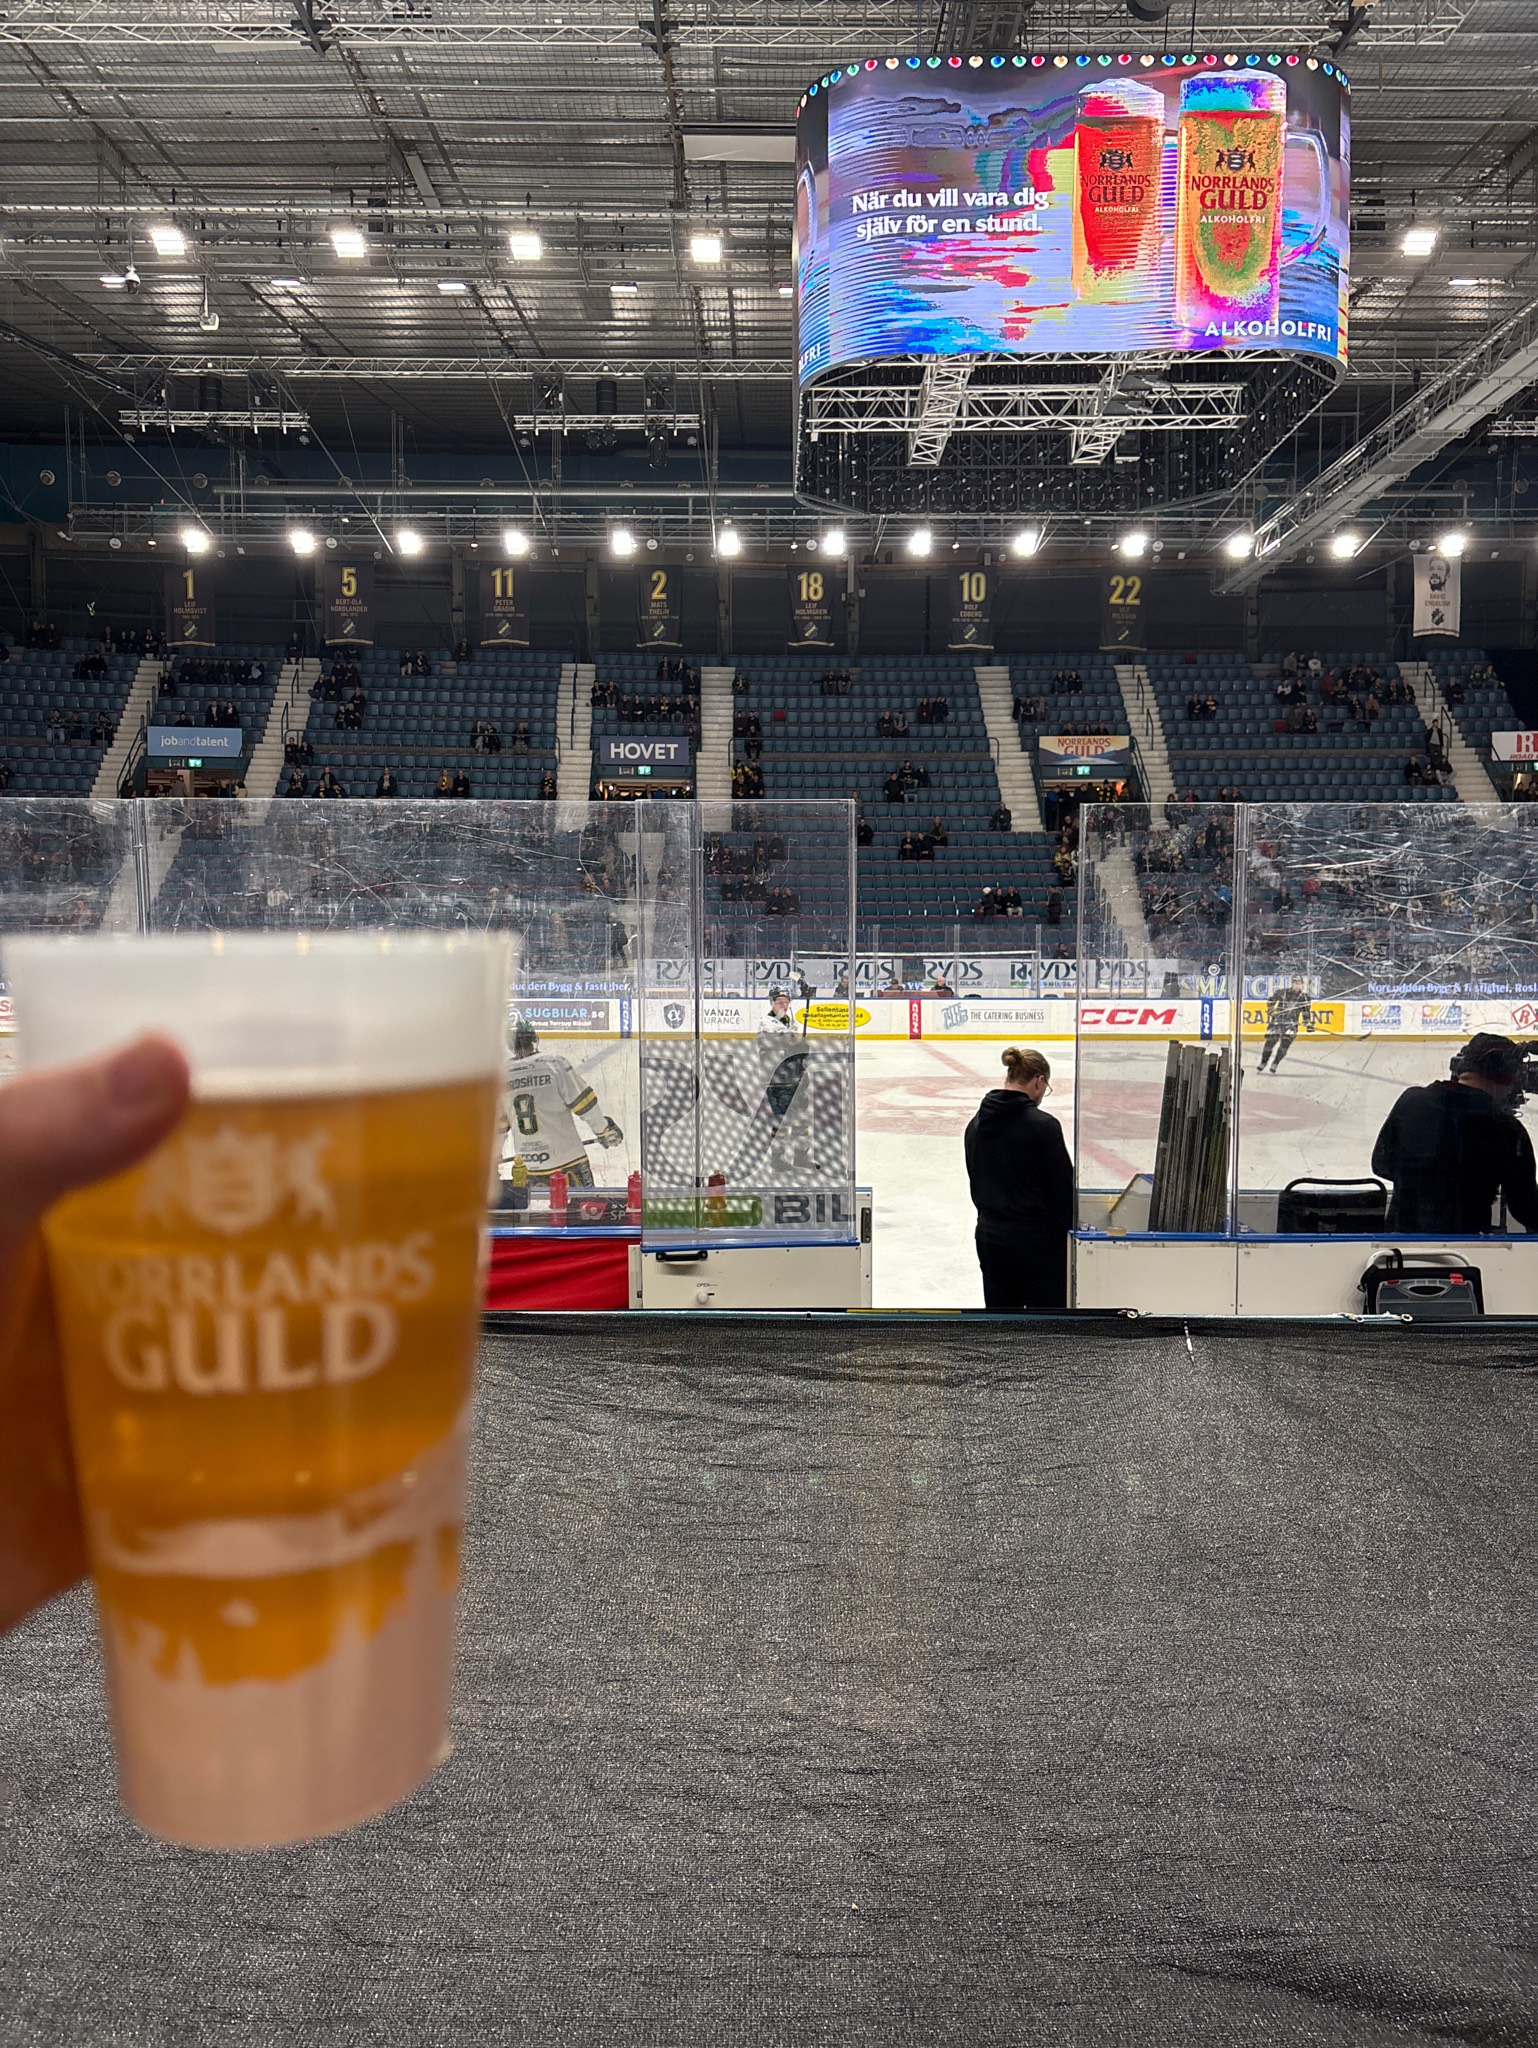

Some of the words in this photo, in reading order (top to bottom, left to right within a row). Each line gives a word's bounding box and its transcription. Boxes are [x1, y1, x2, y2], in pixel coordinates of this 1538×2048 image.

[1082, 174, 1153, 188] NORRLANDS
[1191, 175, 1275, 193] NORRLANDS
[852, 190, 890, 214] När
[893, 188, 922, 209] du
[926, 187, 959, 208] vill
[963, 190, 1009, 207] vara
[1013, 187, 1050, 210] dig
[1089, 186, 1145, 203] GULD
[1200, 189, 1267, 210] GULD
[856, 215, 904, 242] själv
[906, 215, 939, 233] för
[942, 219, 970, 233] en
[975, 213, 1043, 232] stund.
[1200, 215, 1266, 224] ALKOHOLFRI
[1205, 320, 1331, 342] ALKOHOLFRI
[183, 568, 195, 600] 1
[341, 567, 358, 598] 5
[491, 567, 514, 598] 11
[651, 569, 667, 600] 2
[797, 571, 824, 602] 18
[959, 571, 987, 603] 10
[1109, 575, 1142, 605] 22
[173, 607, 207, 615] HOLMQVIST
[161, 735, 229, 748] jobandtalent
[610, 742, 678, 759] HOVET
[1057, 737, 1111, 748] NORRLANDS
[1064, 745, 1105, 757] GULD
[574, 982, 582, 991] &
[970, 1011, 982, 1020] THE
[984, 1011, 1013, 1020] CATERING
[1015, 1011, 1044, 1020] BUSINESS
[1074, 1008, 1177, 1025] CCM
[513, 1093, 539, 1136] 8
[104, 1300, 398, 1395] GULD
